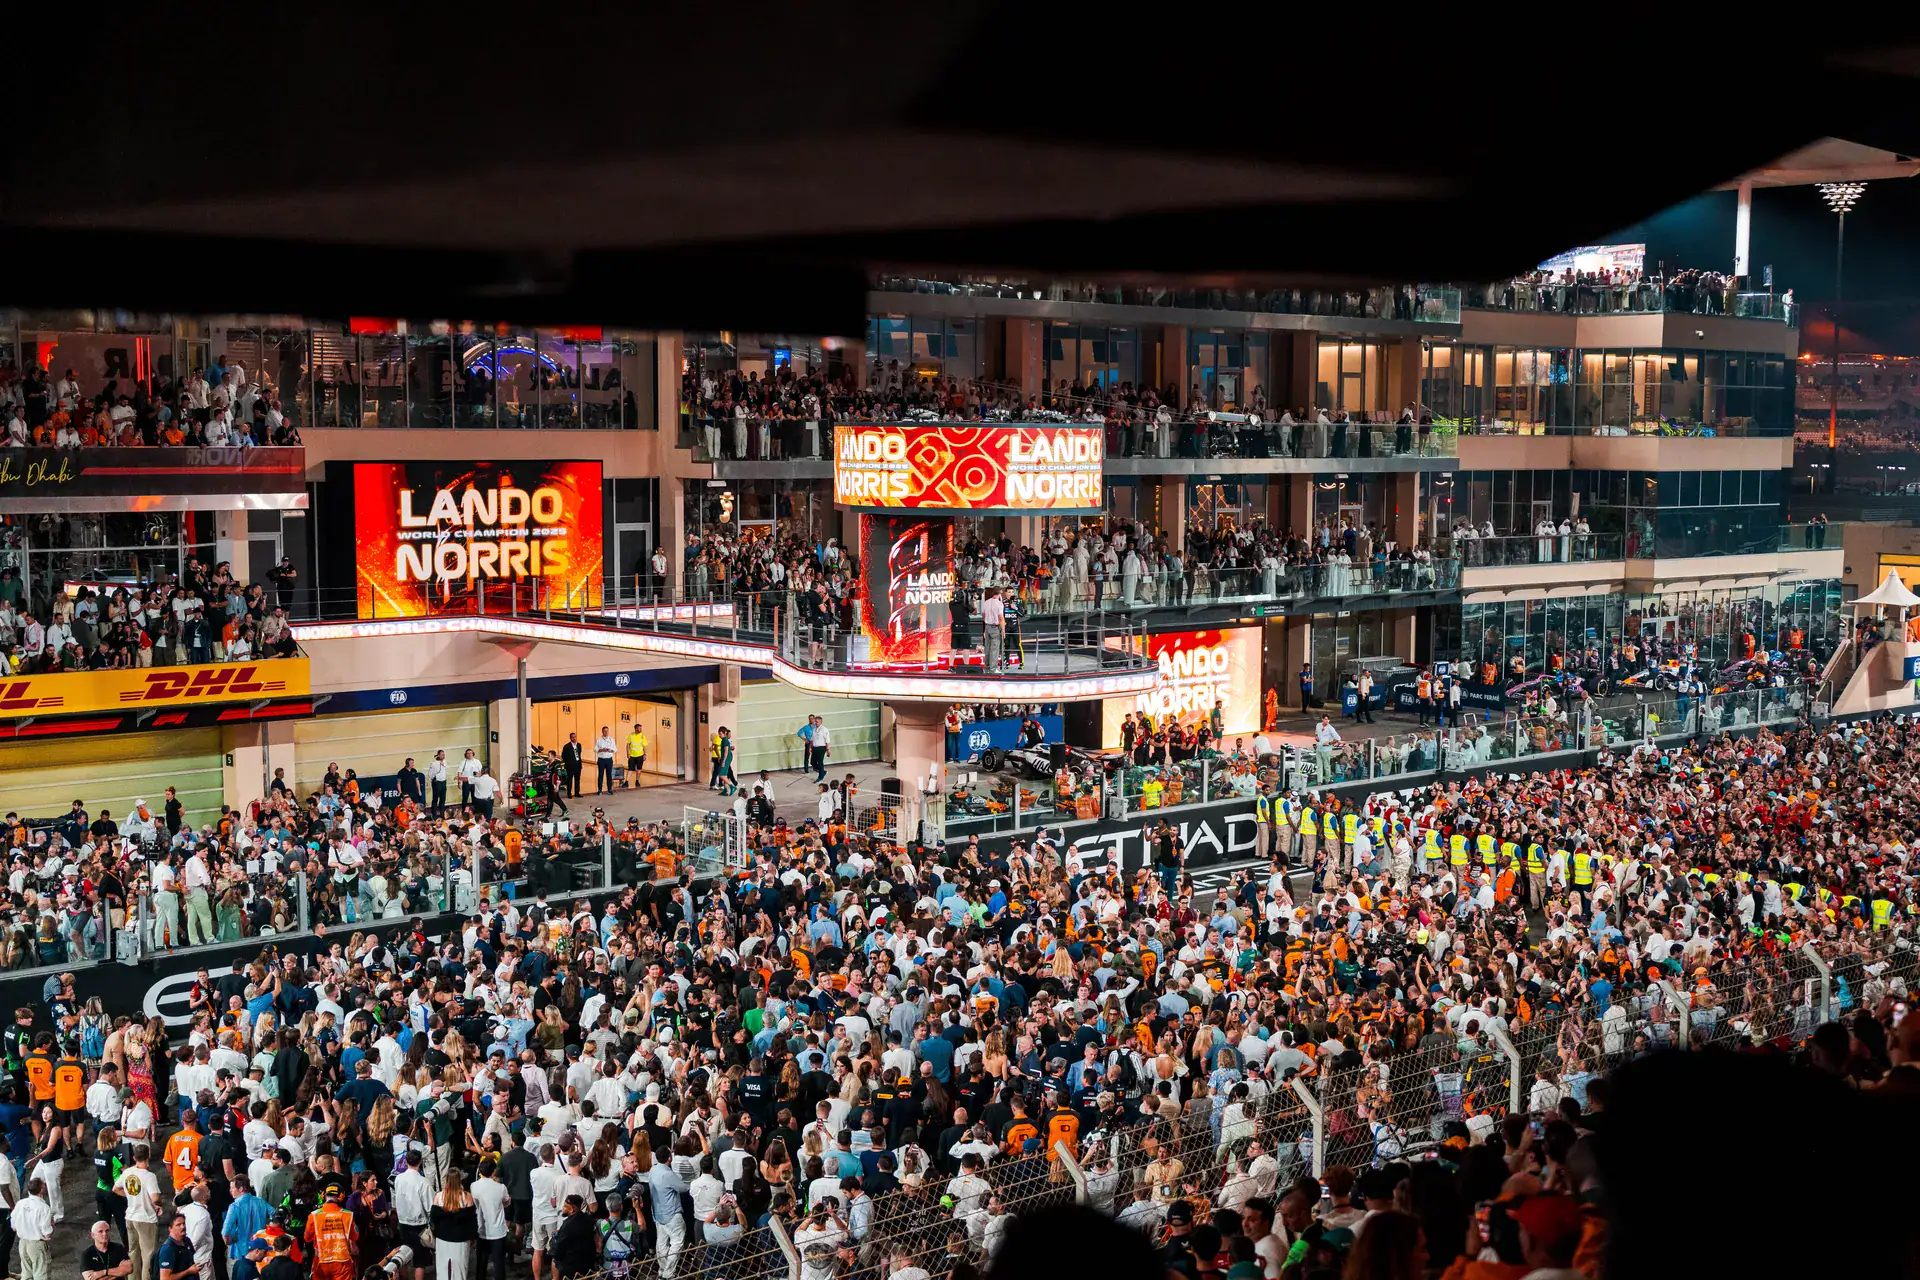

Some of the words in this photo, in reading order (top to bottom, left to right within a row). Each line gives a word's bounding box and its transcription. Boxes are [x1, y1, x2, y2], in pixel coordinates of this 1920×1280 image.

[840, 434, 906, 461] LANDO
[1011, 436, 1100, 462] LANDO
[26, 457, 76, 486] Dhabi
[839, 471, 910, 498] NORRIS
[1006, 473, 1100, 500] NORRIS
[400, 488, 563, 527] LANDO
[397, 531, 450, 541] WORLD
[454, 529, 529, 539] CHAMPION
[532, 528, 567, 537] 2025
[396, 540, 570, 581] NORRIS
[907, 572, 954, 587] LANDO
[357, 621, 441, 636] WORLD
[446, 618, 532, 636] CHAMPION
[647, 639, 707, 656] WORLD
[1158, 647, 1229, 676] ANDO
[144, 667, 265, 700] DHL
[940, 680, 1097, 697] CHAMPION
[1102, 675, 1154, 692] 2025
[1470, 692, 1483, 700] PARC
[1484, 693, 1500, 702] FERMÉ
[1136, 683, 1231, 717] NORRIS
[227, 757, 232, 765] 5
[177, 1147, 191, 1170] 4
